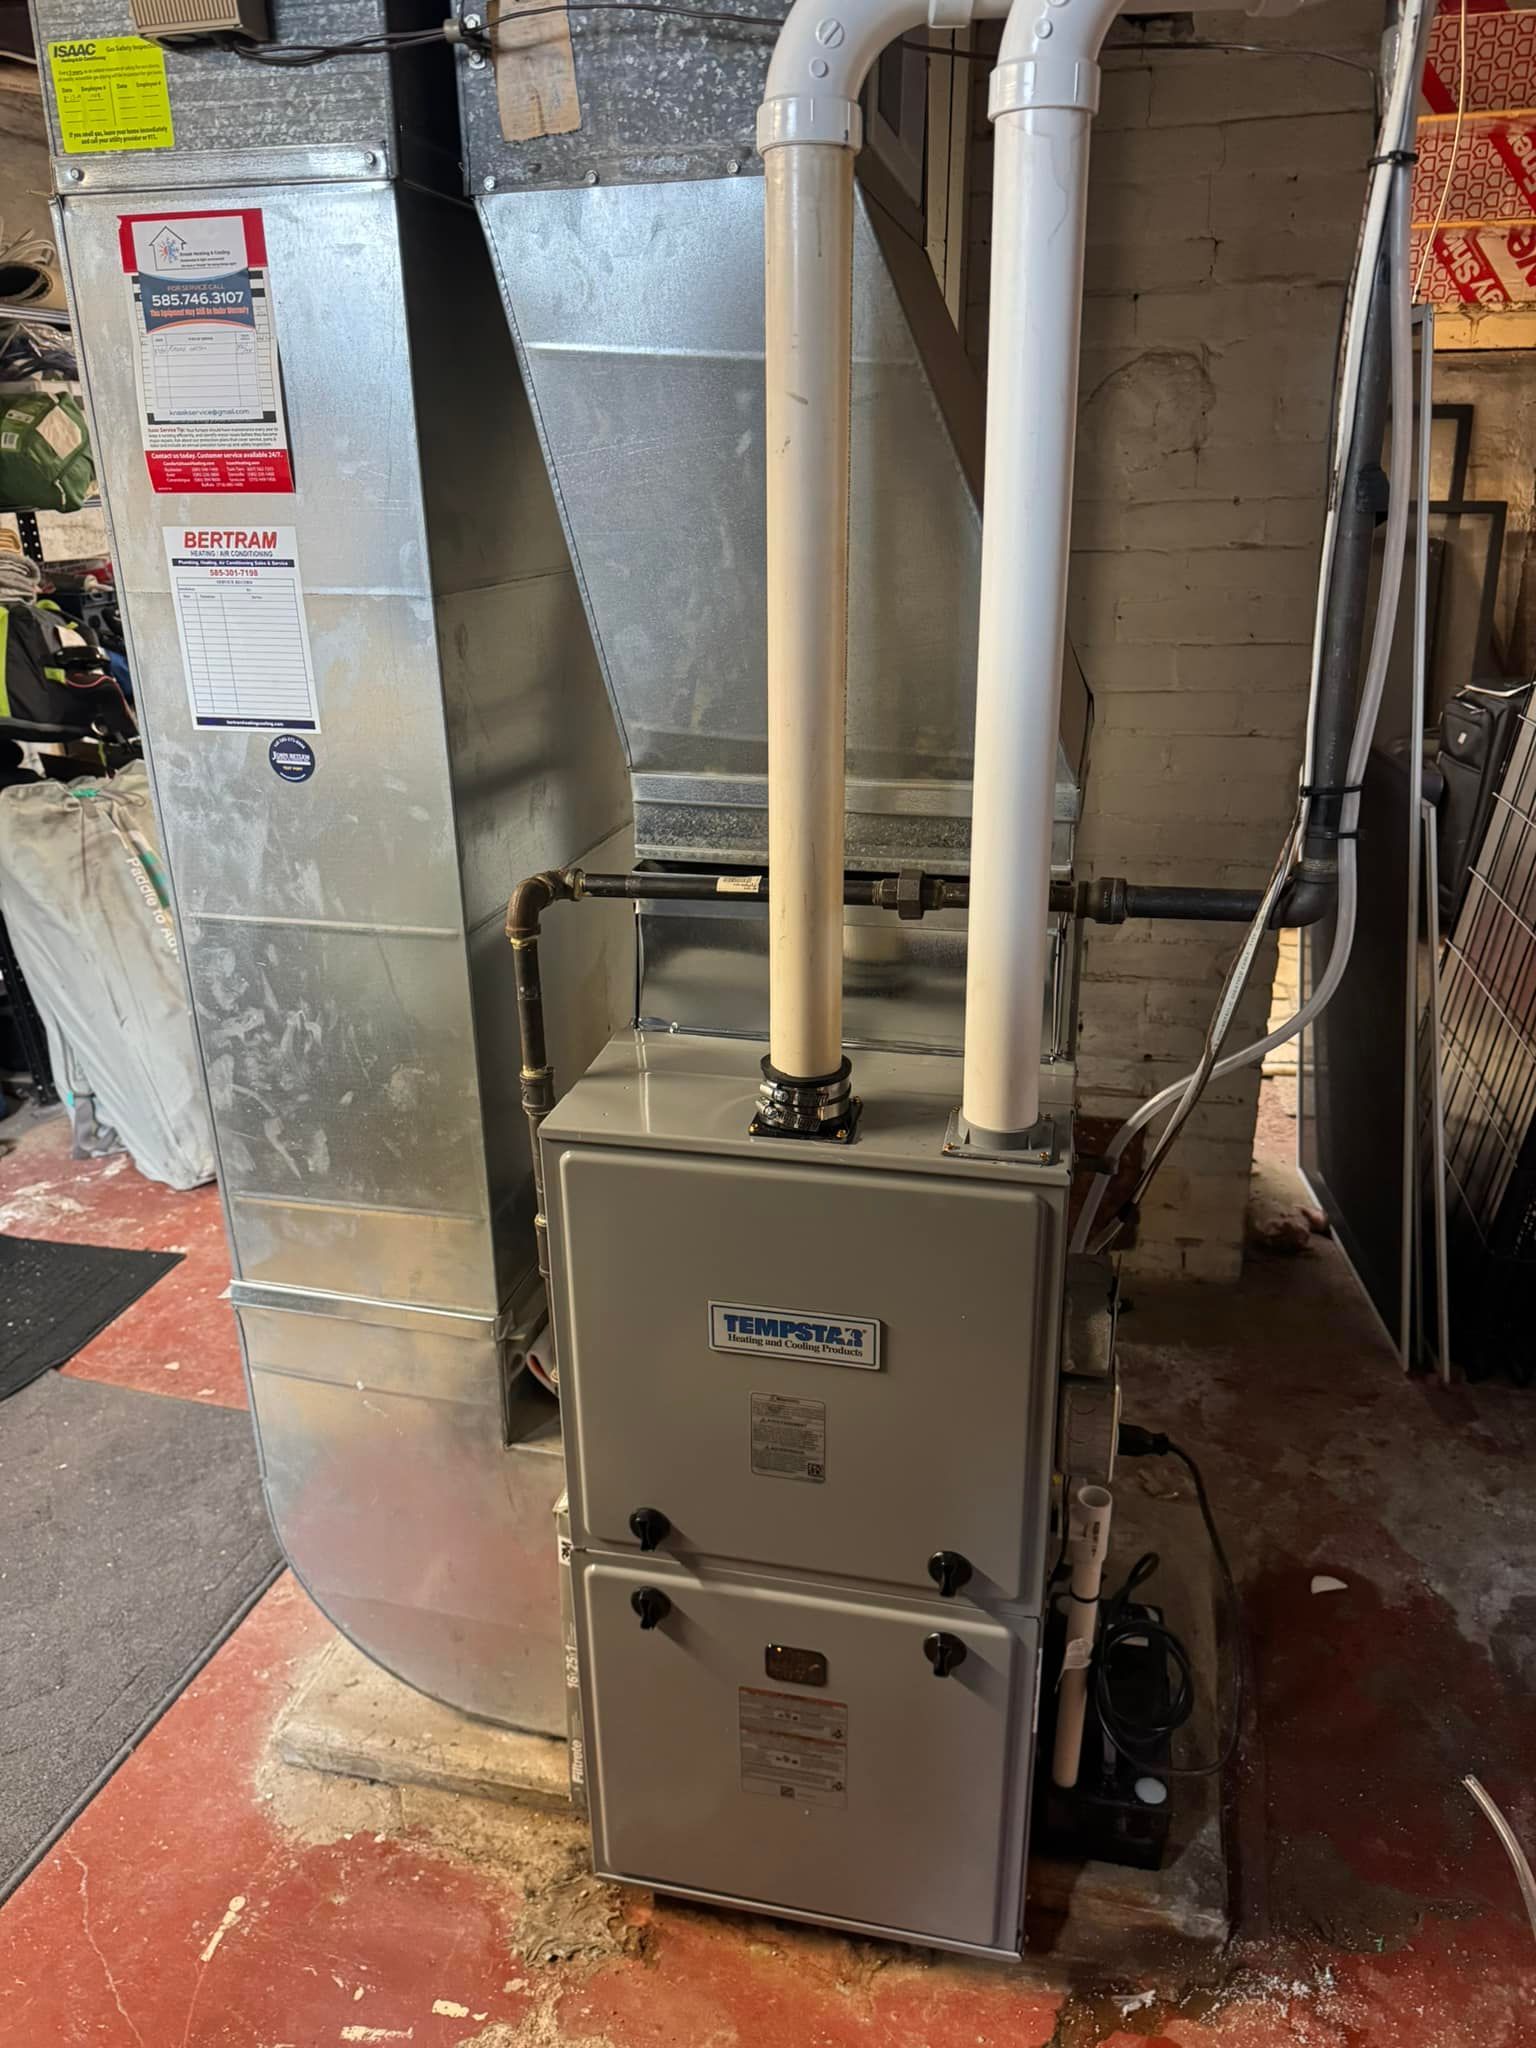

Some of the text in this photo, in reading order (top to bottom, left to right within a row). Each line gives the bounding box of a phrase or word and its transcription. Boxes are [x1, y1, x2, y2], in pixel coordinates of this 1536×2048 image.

[54, 43, 96, 58] ISAAC
[152, 291, 244, 307] 585.746.3107
[184, 531, 278, 549] BERTRAM
[126, 856, 158, 907] Paddle
[152, 907, 166, 924] to
[723, 1313, 863, 1348] TEMPSTAR
[728, 1333, 863, 1358] Heating and Cooling Products
